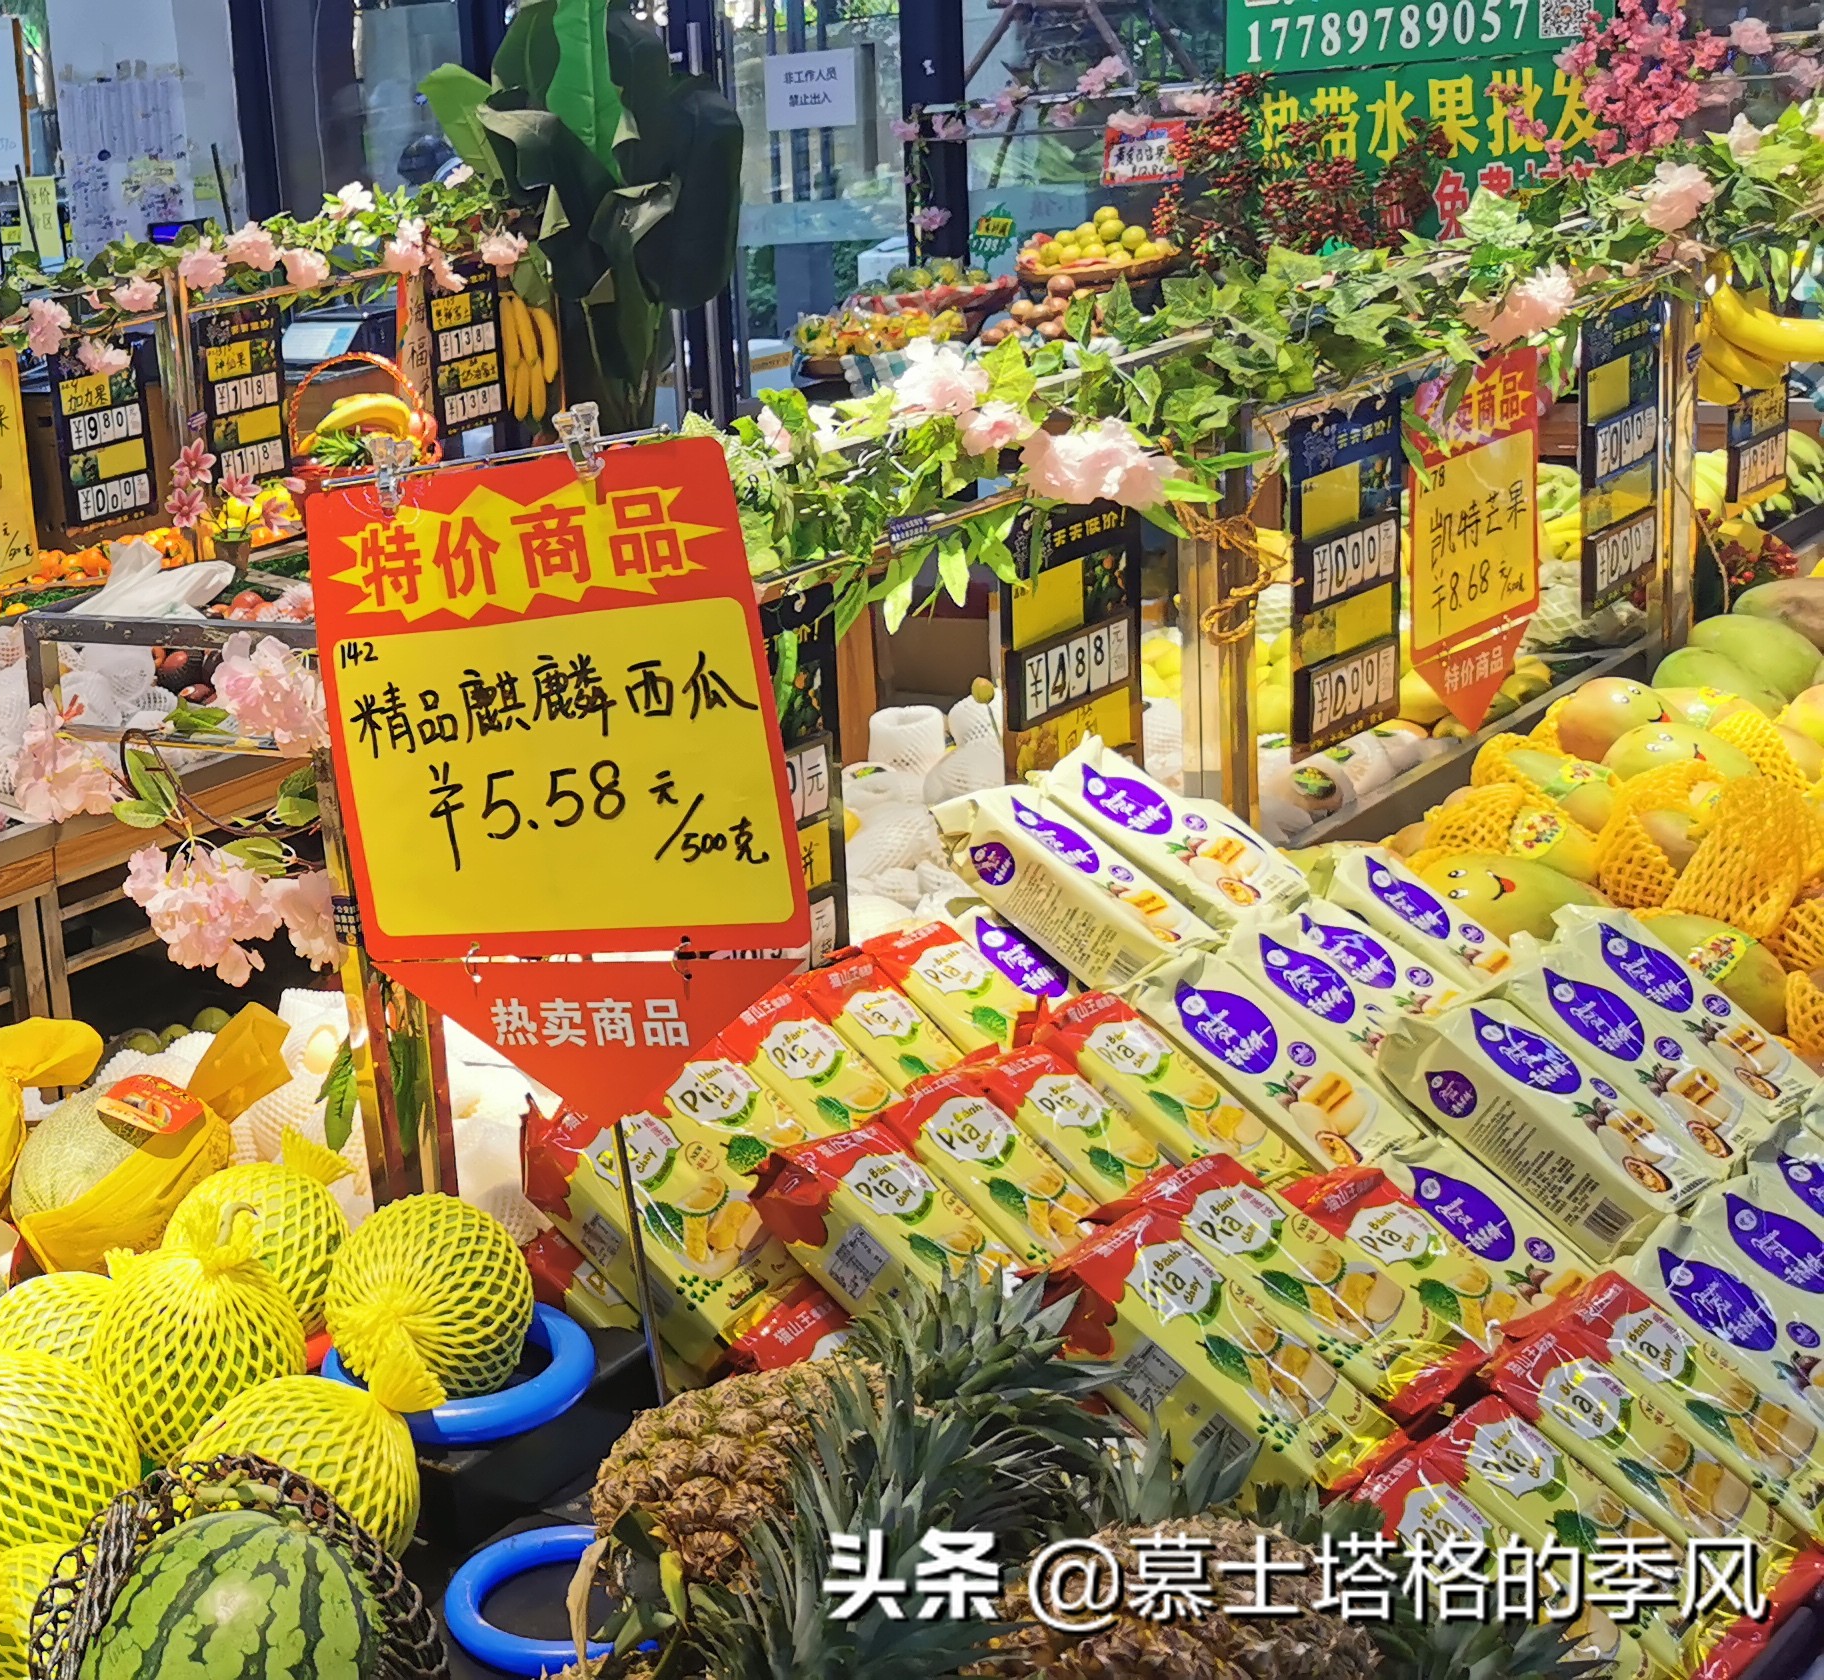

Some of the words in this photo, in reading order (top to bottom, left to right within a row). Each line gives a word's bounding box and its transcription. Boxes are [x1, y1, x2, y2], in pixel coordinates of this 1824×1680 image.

[1247, 0, 1527, 63] 17789789057
[784, 66, 838, 84] 非工作人员
[789, 91, 832, 107] 禁止出入
[359, 492, 686, 606] 特价商品
[1052, 505, 1127, 549] 天天低价!
[1429, 480, 1527, 569] 凯特芒果
[1444, 645, 1505, 695] 特价商品
[351, 651, 759, 760] 精品麒麟西瓜
[491, 997, 692, 1047] 热卖商品
